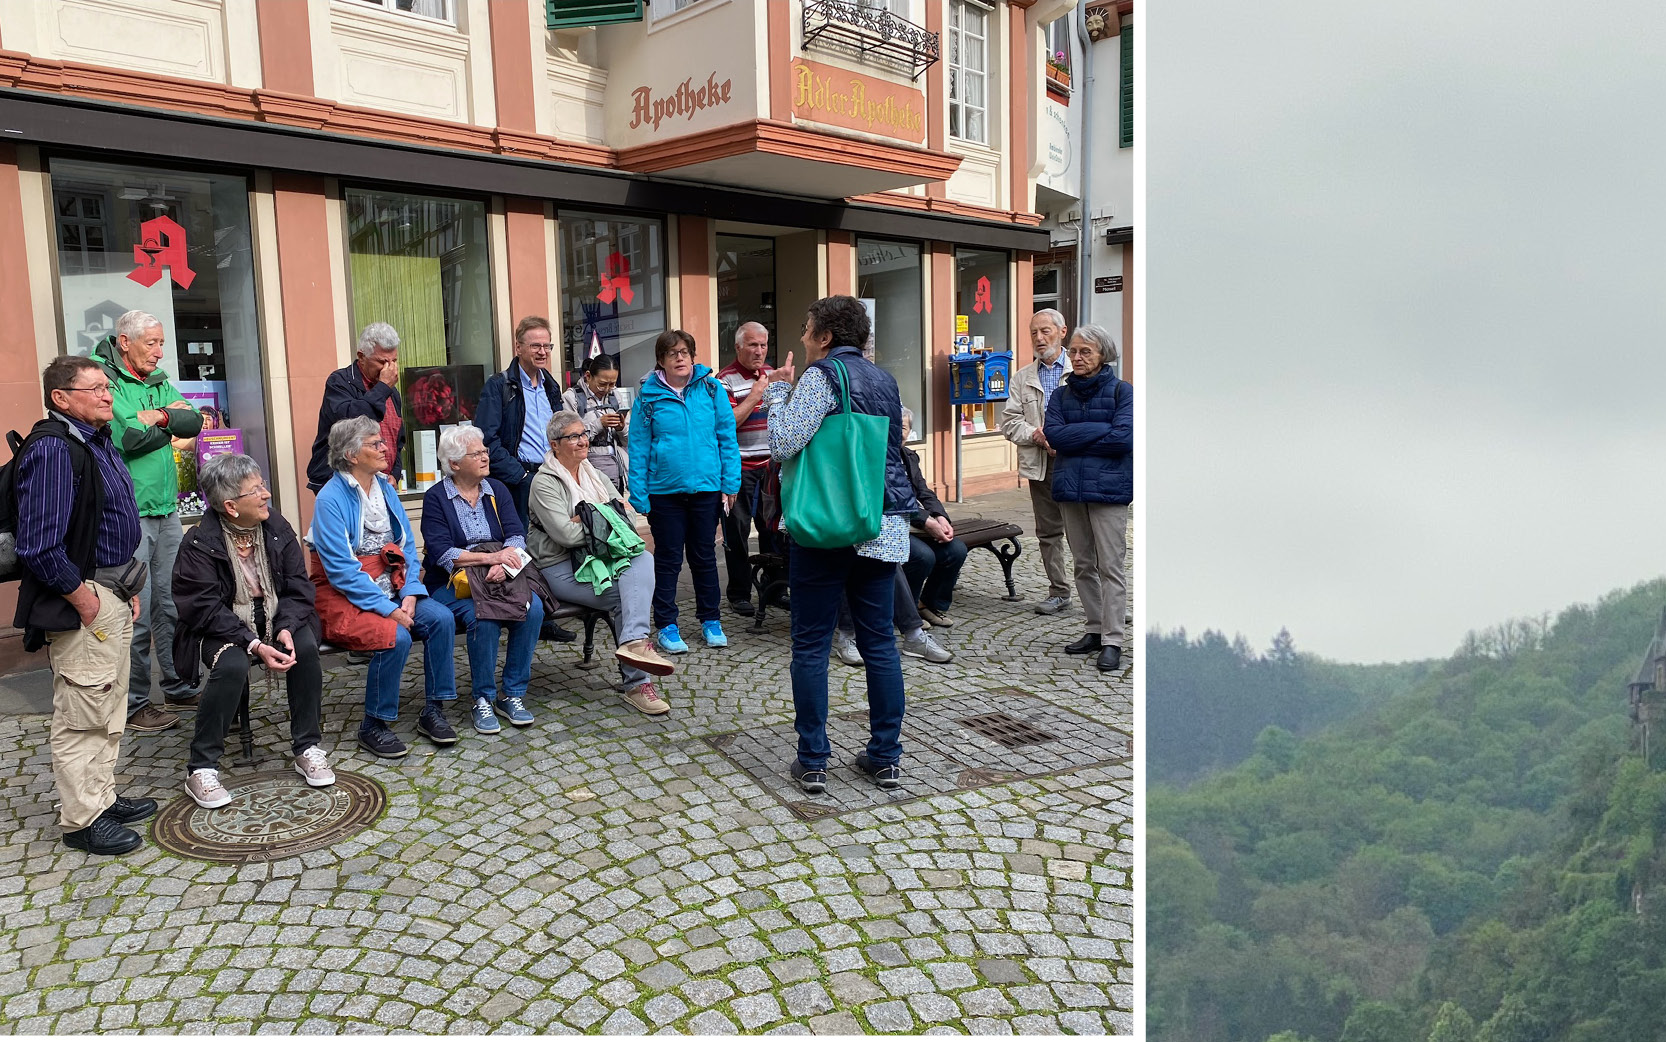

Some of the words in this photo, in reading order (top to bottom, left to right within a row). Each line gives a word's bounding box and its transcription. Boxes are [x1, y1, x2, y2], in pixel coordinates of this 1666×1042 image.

[629, 71, 731, 132] Apotheke
[794, 65, 848, 116] Adler
[848, 79, 921, 133] Apotheke
[204, 832, 233, 842] DAS
[237, 834, 286, 843] SPIEL
